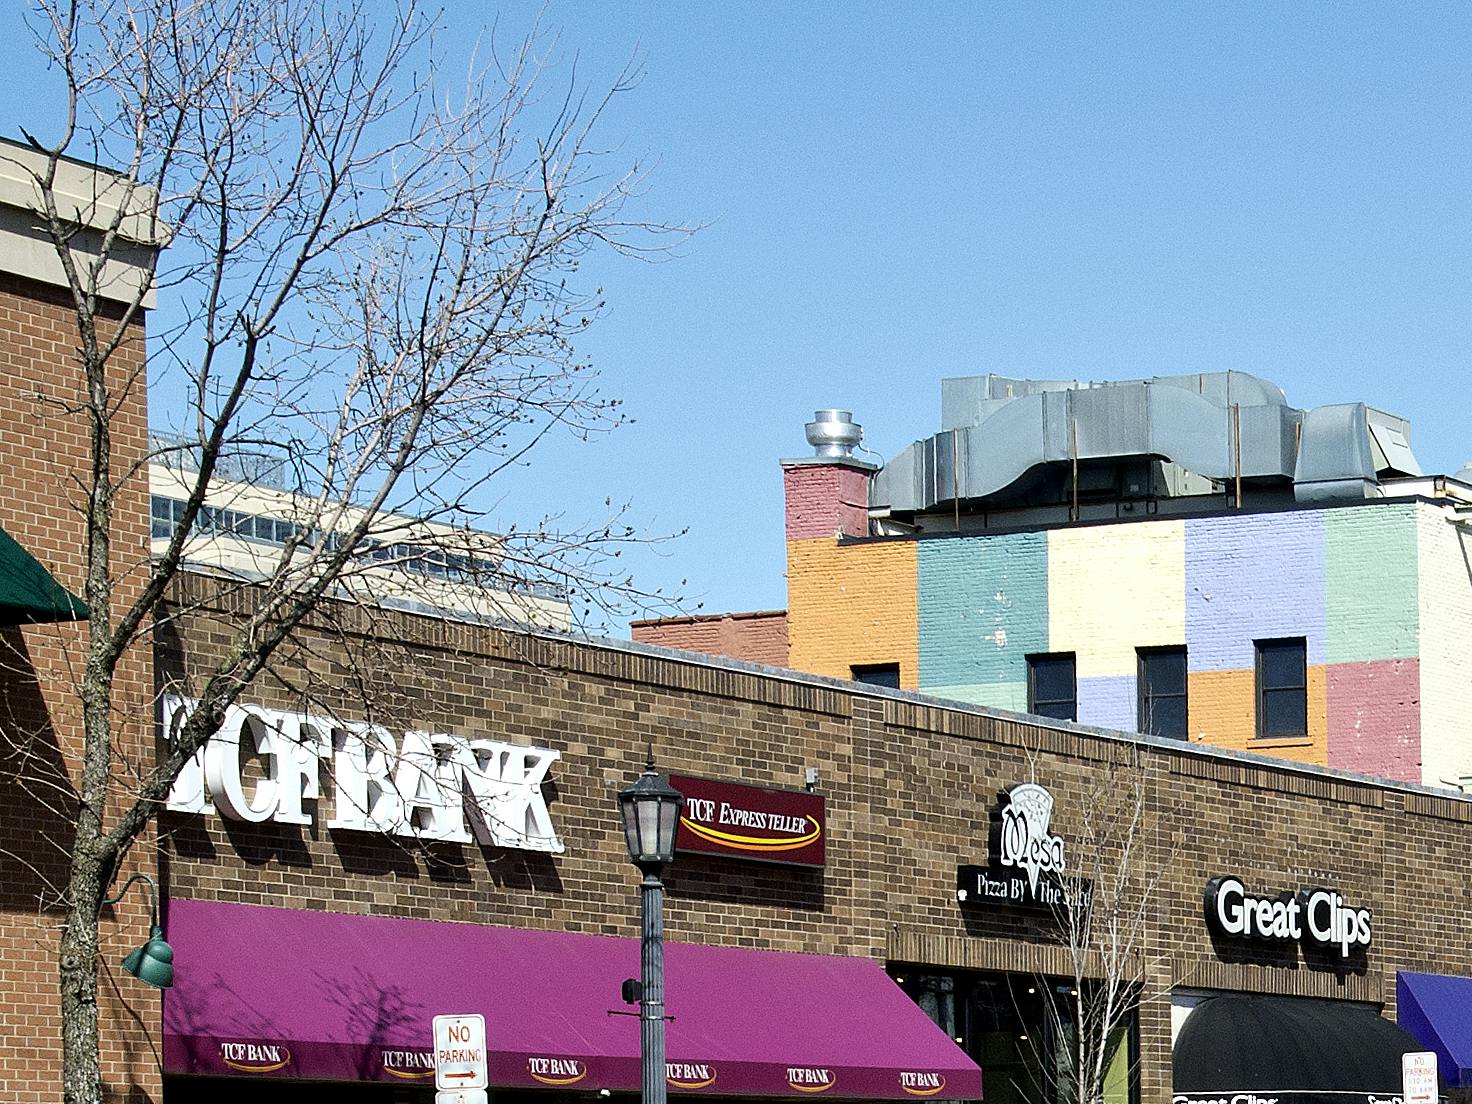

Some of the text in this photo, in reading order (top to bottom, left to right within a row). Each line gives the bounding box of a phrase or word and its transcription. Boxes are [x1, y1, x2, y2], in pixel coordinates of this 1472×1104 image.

[162, 692, 566, 854] TCF BANK
[687, 798, 715, 819] TCF
[768, 811, 806, 834] TELLER
[1003, 808, 1064, 868] Mesa
[977, 872, 1007, 897] Pizza
[1041, 880, 1062, 905] The
[1217, 880, 1371, 957] Great Clips
[448, 1025, 471, 1043] NO
[222, 1043, 281, 1063] TCF BANK
[382, 1051, 435, 1069] TCF BANK
[439, 1049, 481, 1063] PARKING
[1414, 1057, 1425, 1066] NO
[529, 1058, 579, 1075] TCF BANK
[665, 1063, 709, 1080] TCF BANK
[787, 1069, 829, 1084] TCF BANK
[900, 1072, 940, 1088] TCF BANK
